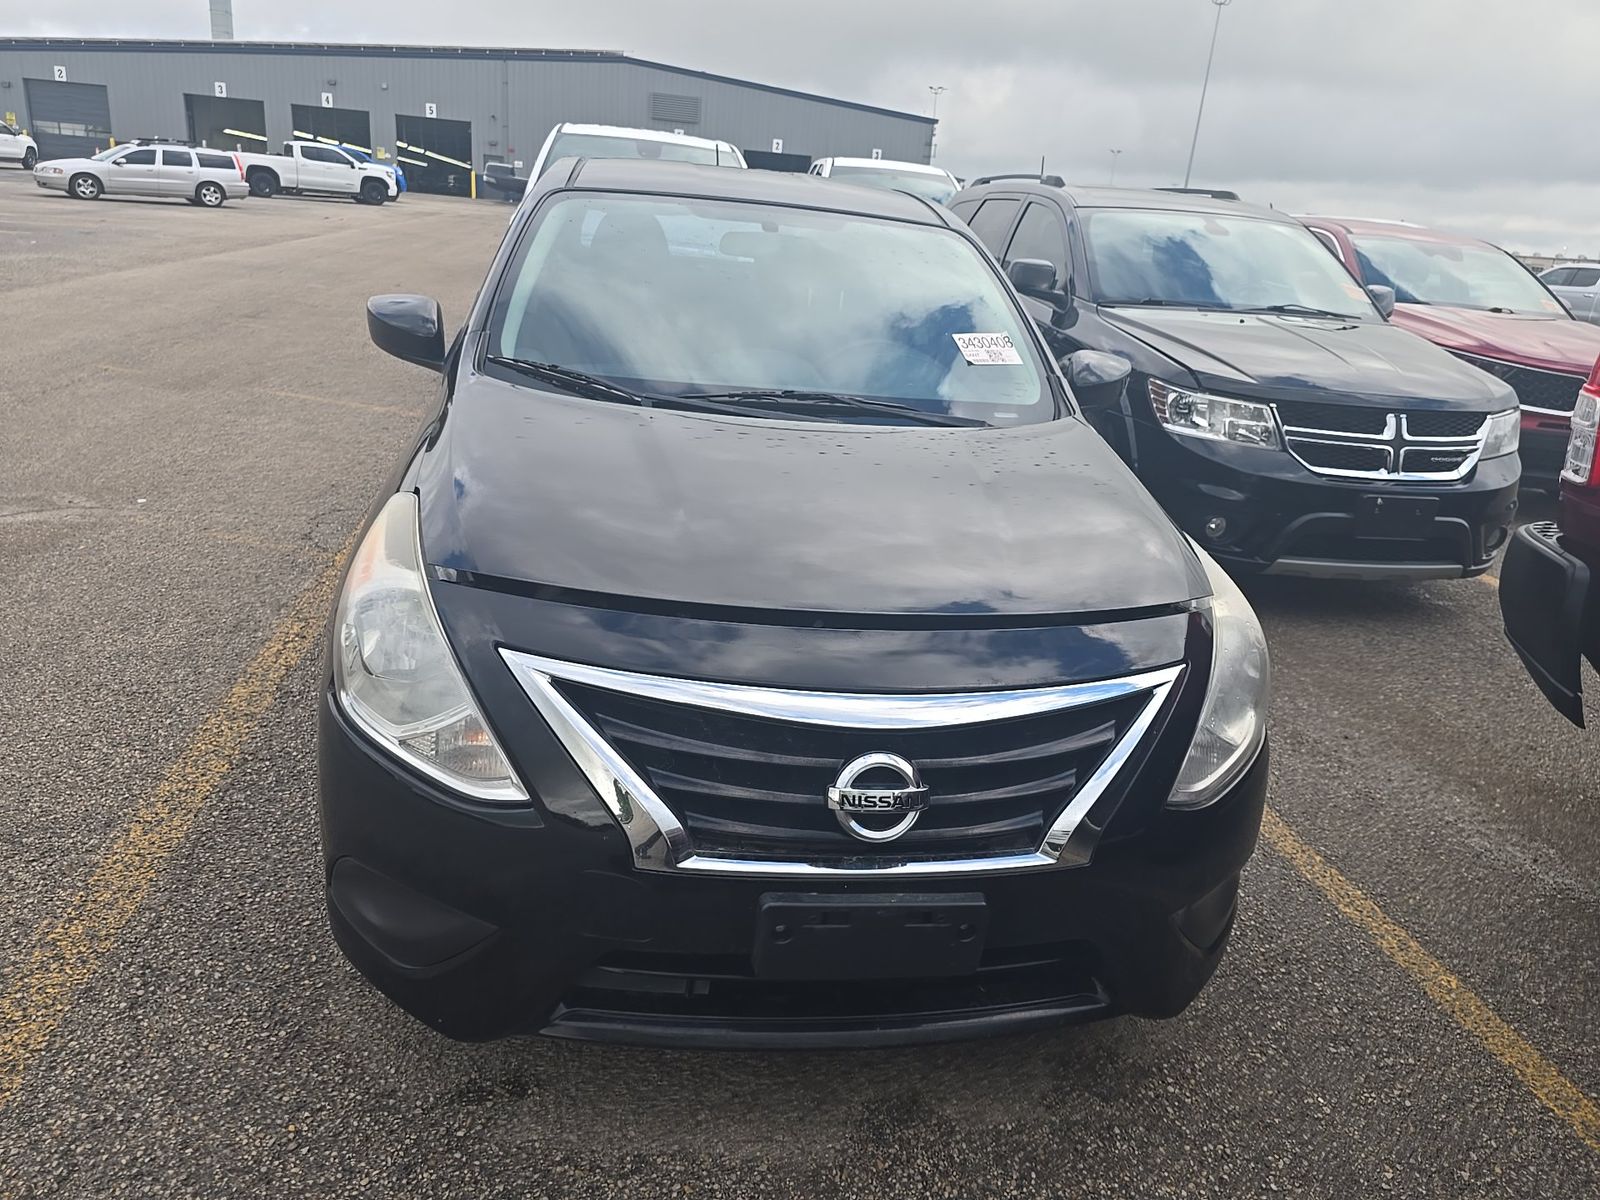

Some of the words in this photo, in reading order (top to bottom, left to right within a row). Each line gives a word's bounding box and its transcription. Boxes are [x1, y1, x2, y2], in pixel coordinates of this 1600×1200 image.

[57, 68, 64, 79] 2
[217, 84, 224, 95] 3
[428, 105, 434, 115] 5
[958, 335, 1014, 349] 3430408
[841, 793, 920, 809] NISSAN
